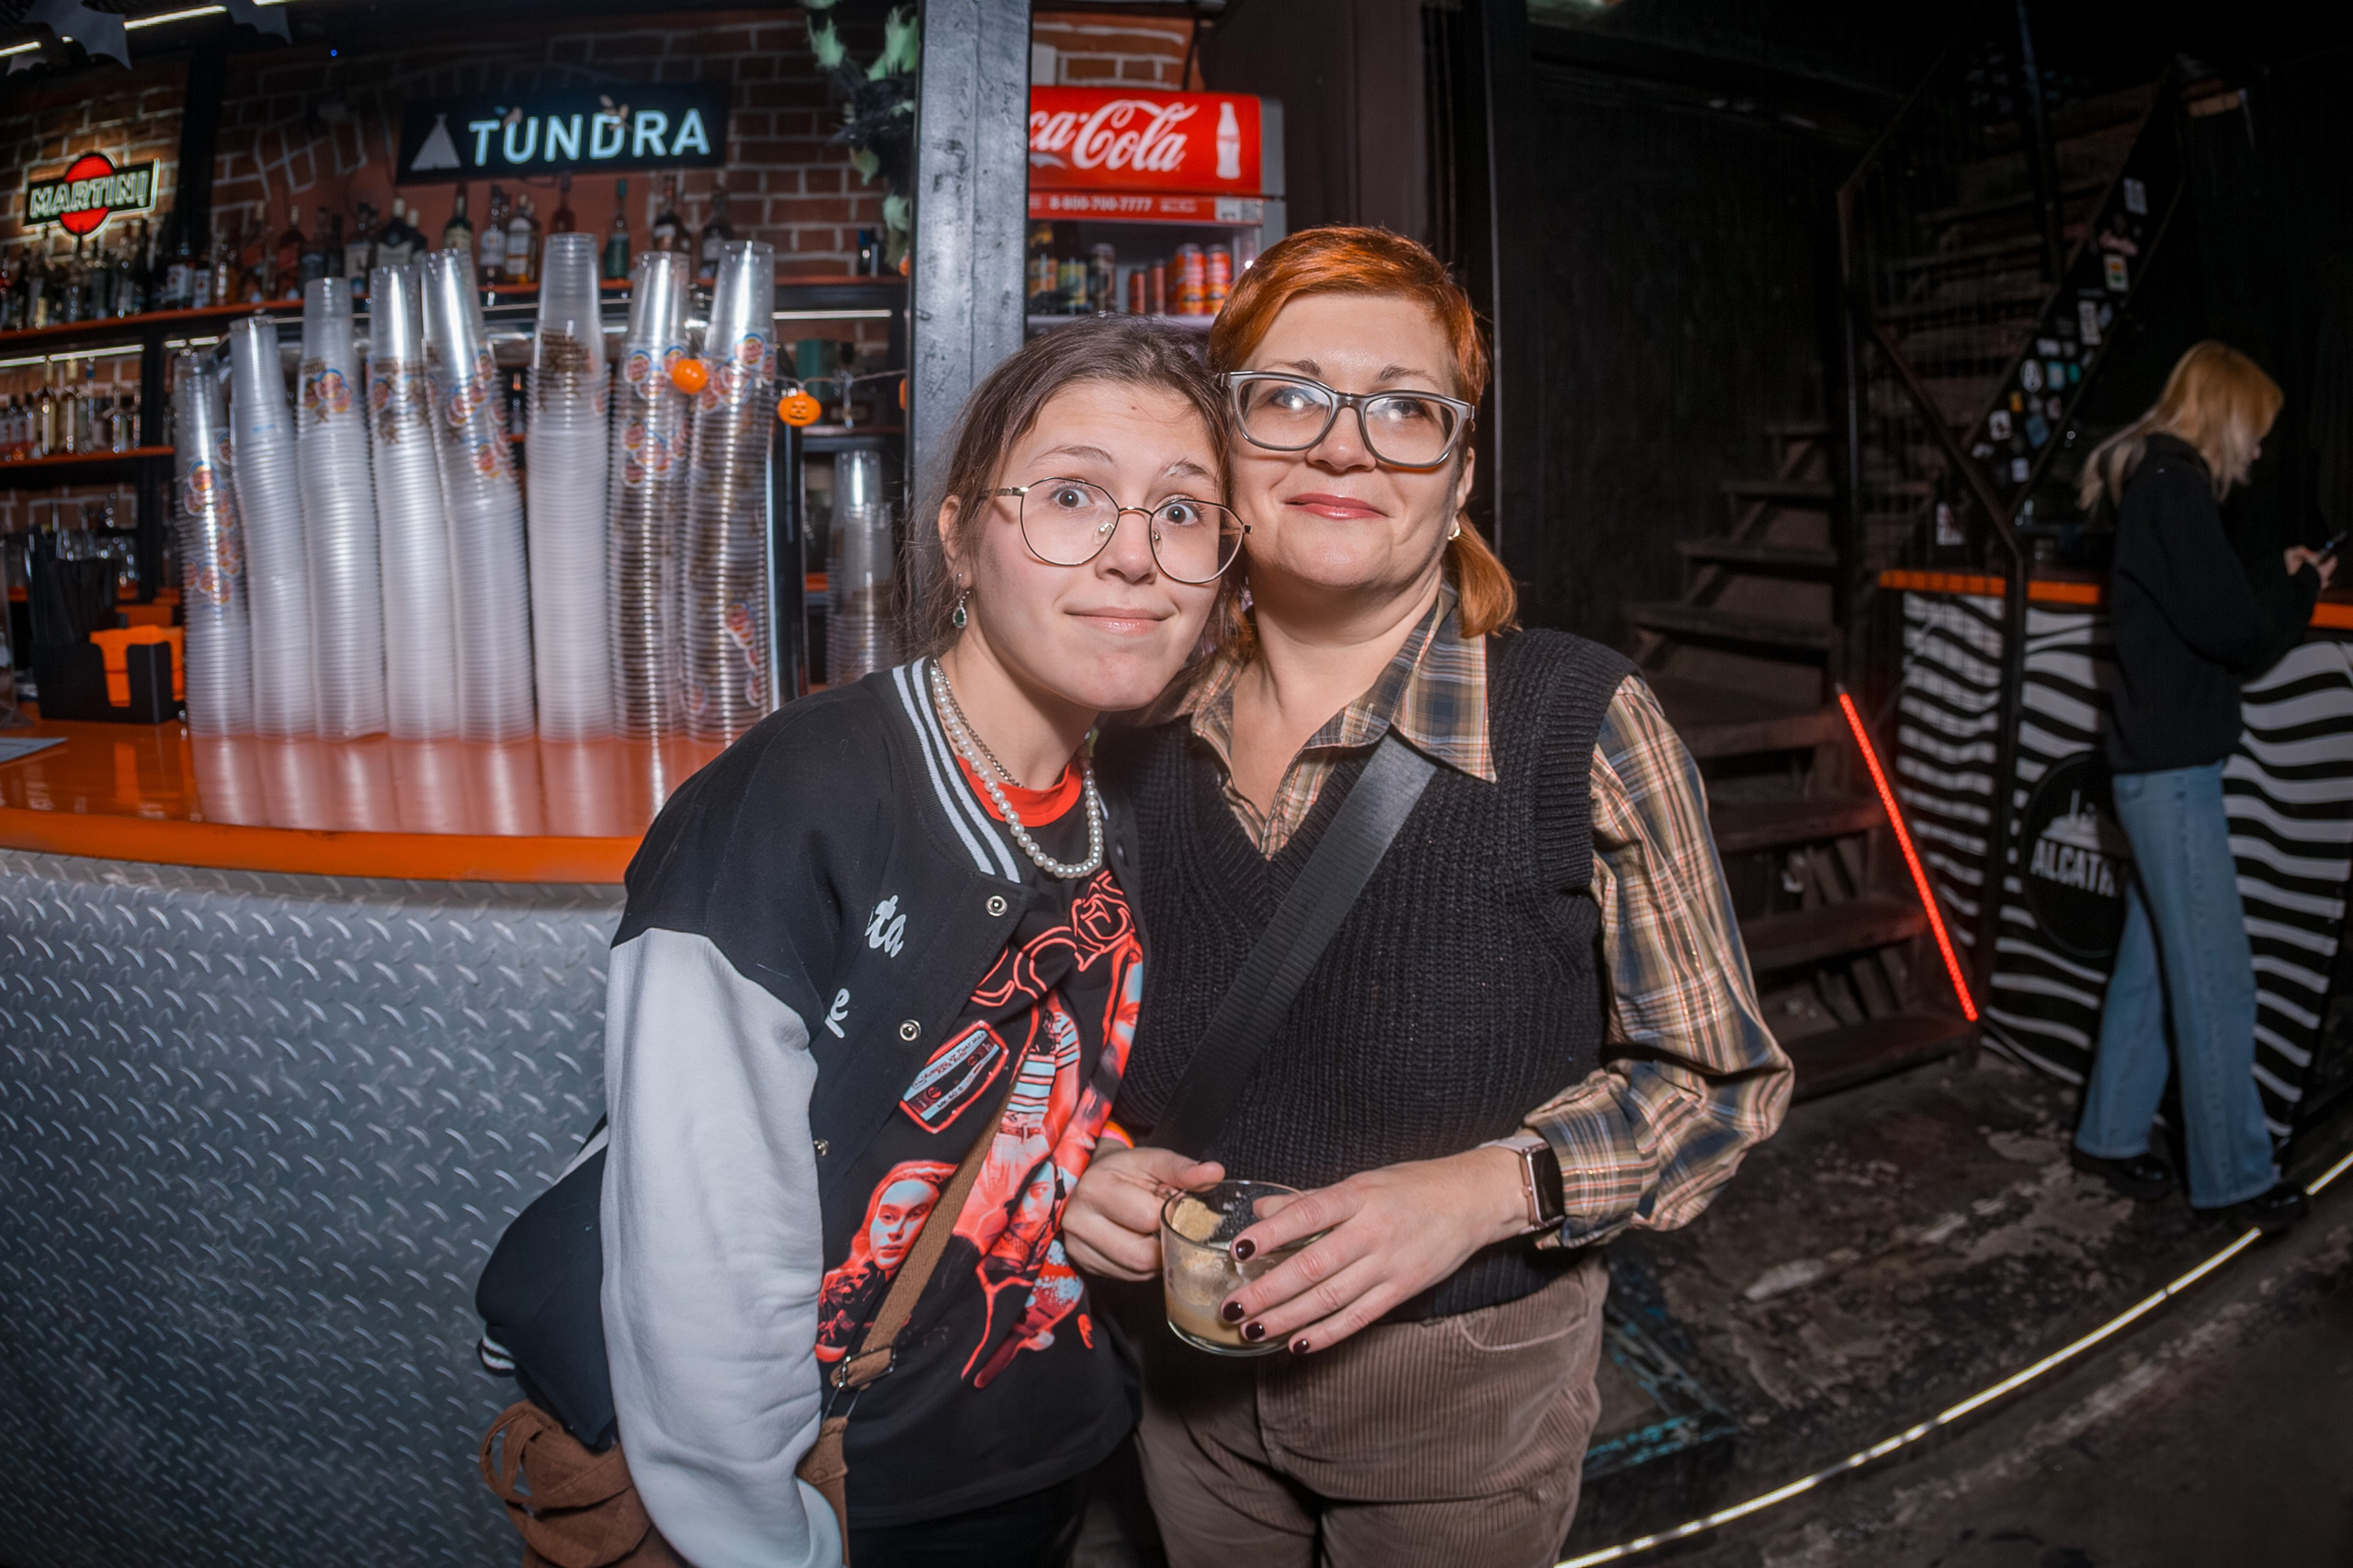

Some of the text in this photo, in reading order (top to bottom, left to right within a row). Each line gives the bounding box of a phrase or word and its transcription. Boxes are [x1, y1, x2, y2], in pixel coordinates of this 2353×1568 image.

[469, 108, 711, 166] TUNDRA
[1029, 99, 1199, 172] ca-Cola
[29, 170, 150, 219] MARTINI
